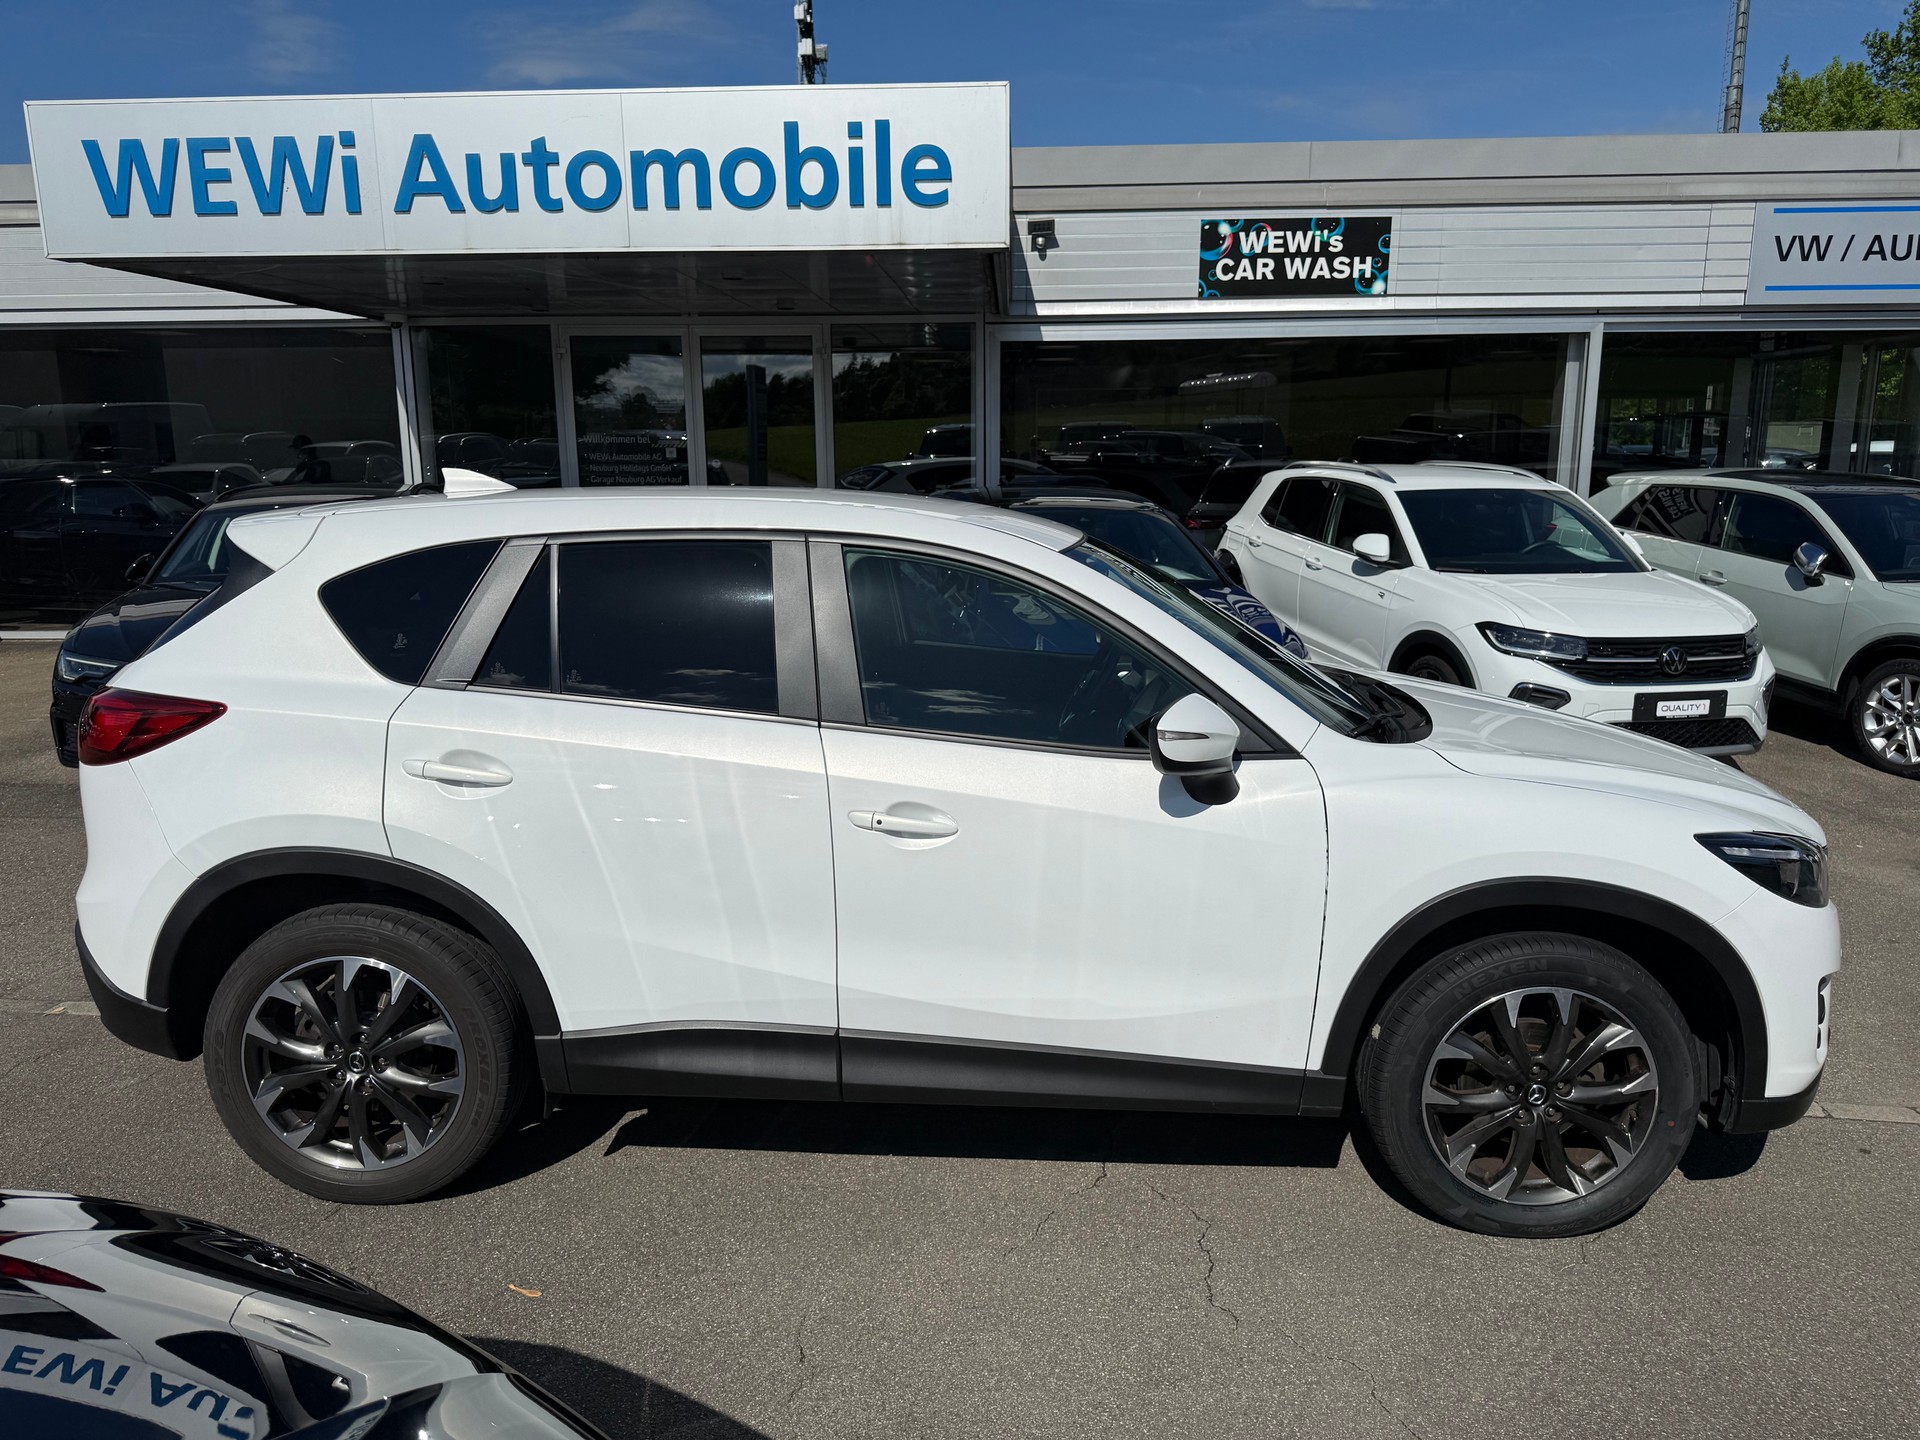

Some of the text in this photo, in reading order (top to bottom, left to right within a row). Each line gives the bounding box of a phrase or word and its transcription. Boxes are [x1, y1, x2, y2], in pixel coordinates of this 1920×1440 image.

[81, 119, 953, 217] WEWi Automobile
[1239, 229, 1344, 254] WEWi's
[1774, 235, 1834, 262] VW
[1215, 256, 1373, 281] CAR WASH
[583, 434, 651, 444] Willkommen bei
[612, 453, 651, 461] Automobile
[652, 453, 663, 461] AG
[589, 464, 672, 473] Neuburg Holidays GmbH
[590, 475, 683, 485] Garage Neuburg AG Verkauf
[1660, 703, 1702, 713] QUALITY
[1454, 958, 1548, 1001] NEXEN
